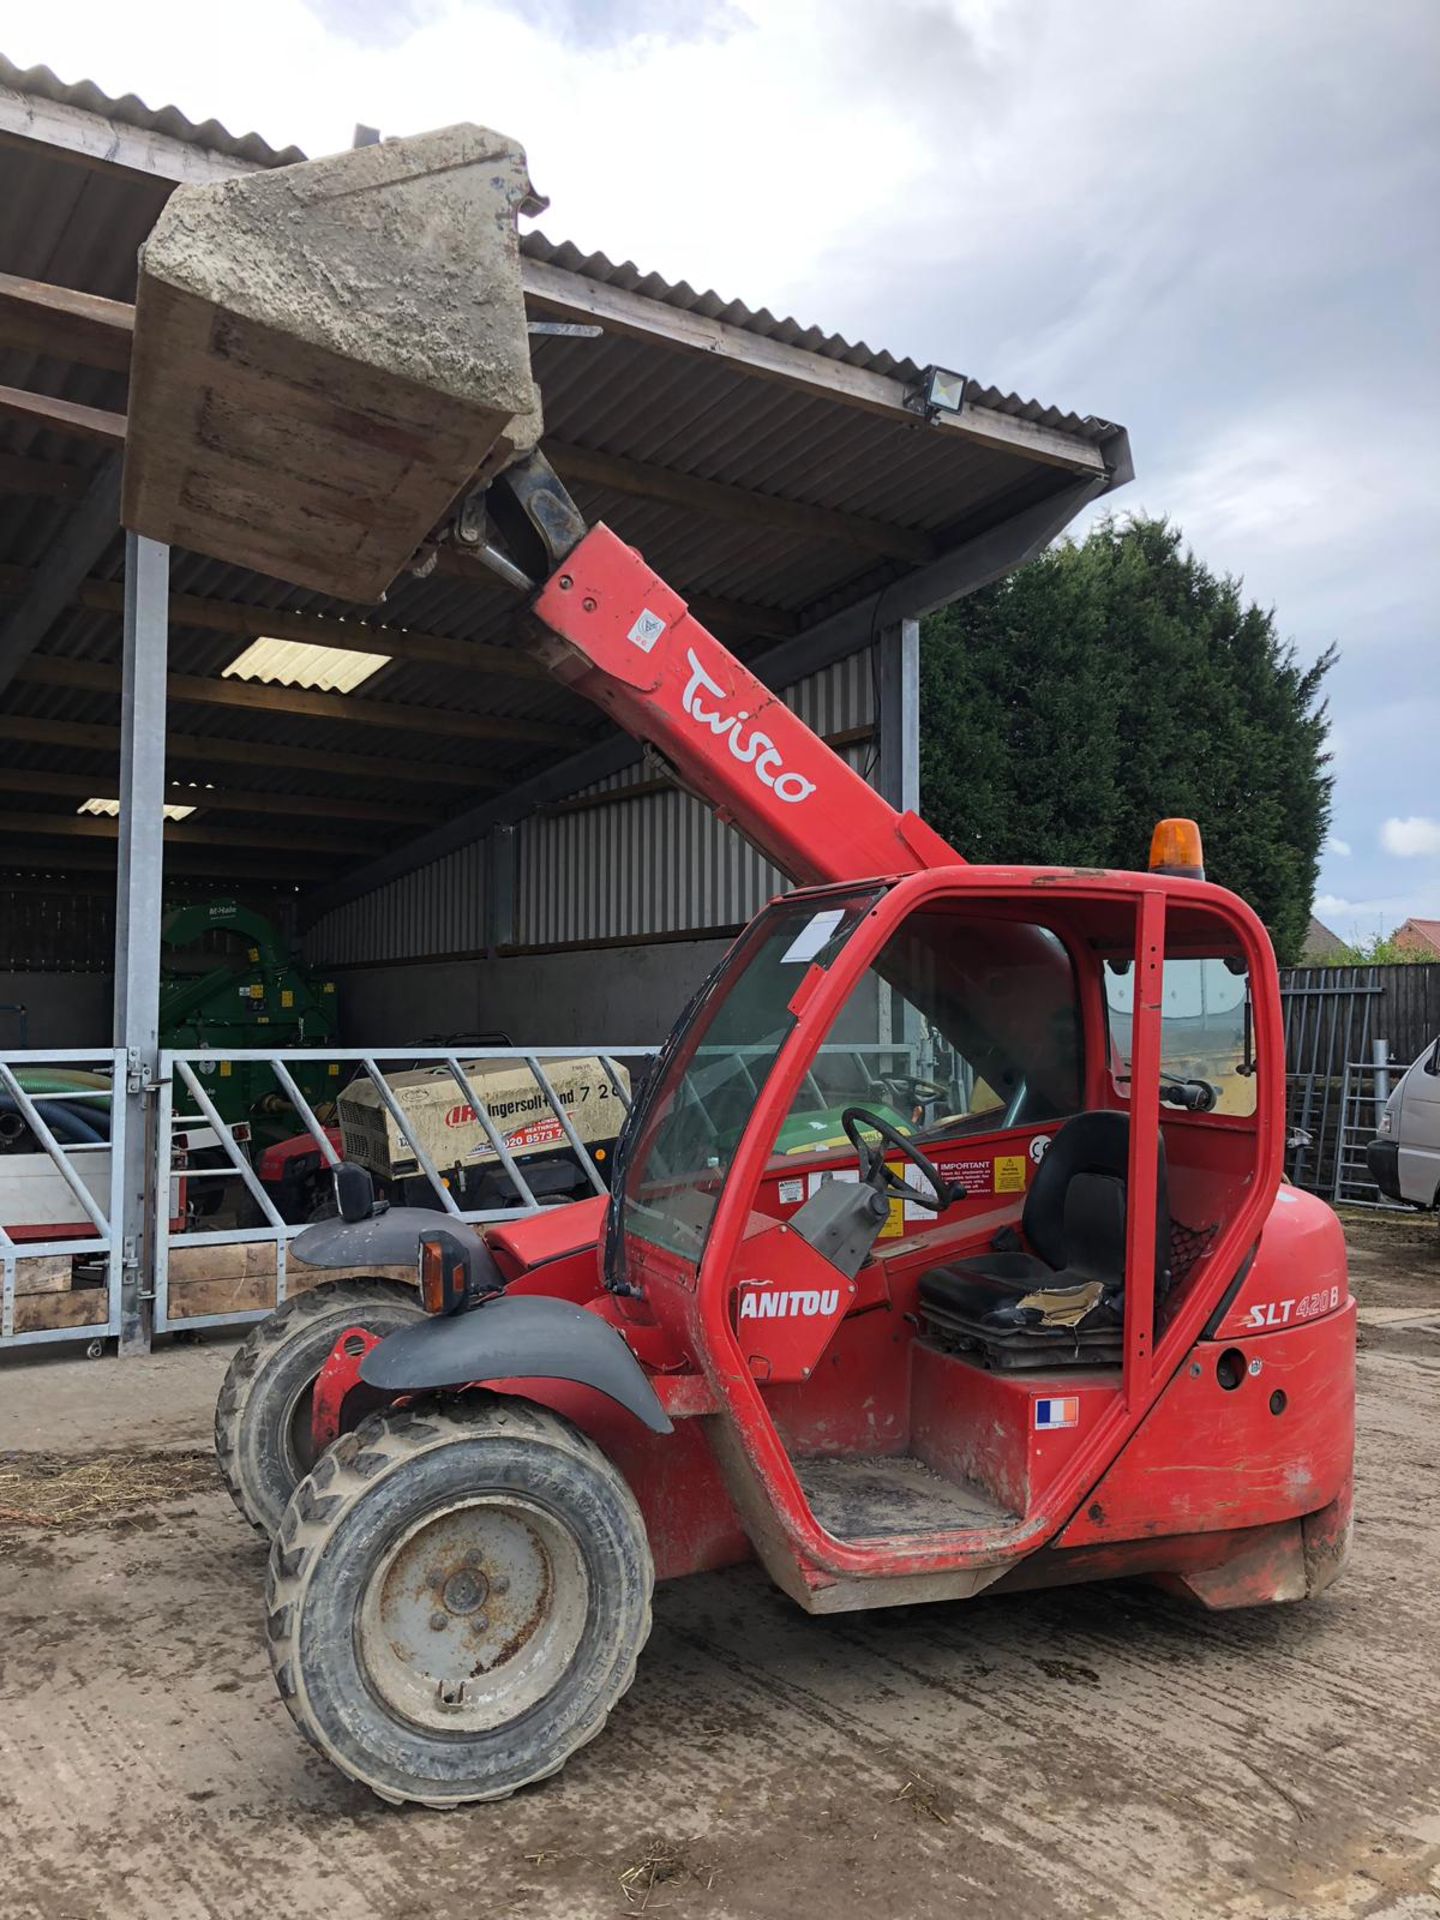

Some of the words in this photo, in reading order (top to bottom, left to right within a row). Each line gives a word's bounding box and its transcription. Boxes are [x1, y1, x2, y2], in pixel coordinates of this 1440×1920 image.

[682, 647, 816, 803] Twisco
[524, 1122, 560, 1134] HEATHROW
[526, 1131, 553, 1143] 8573
[940, 1161, 990, 1170] IMPORTANT
[740, 1289, 840, 1319] ANITOU
[1247, 1299, 1296, 1328] SLT
